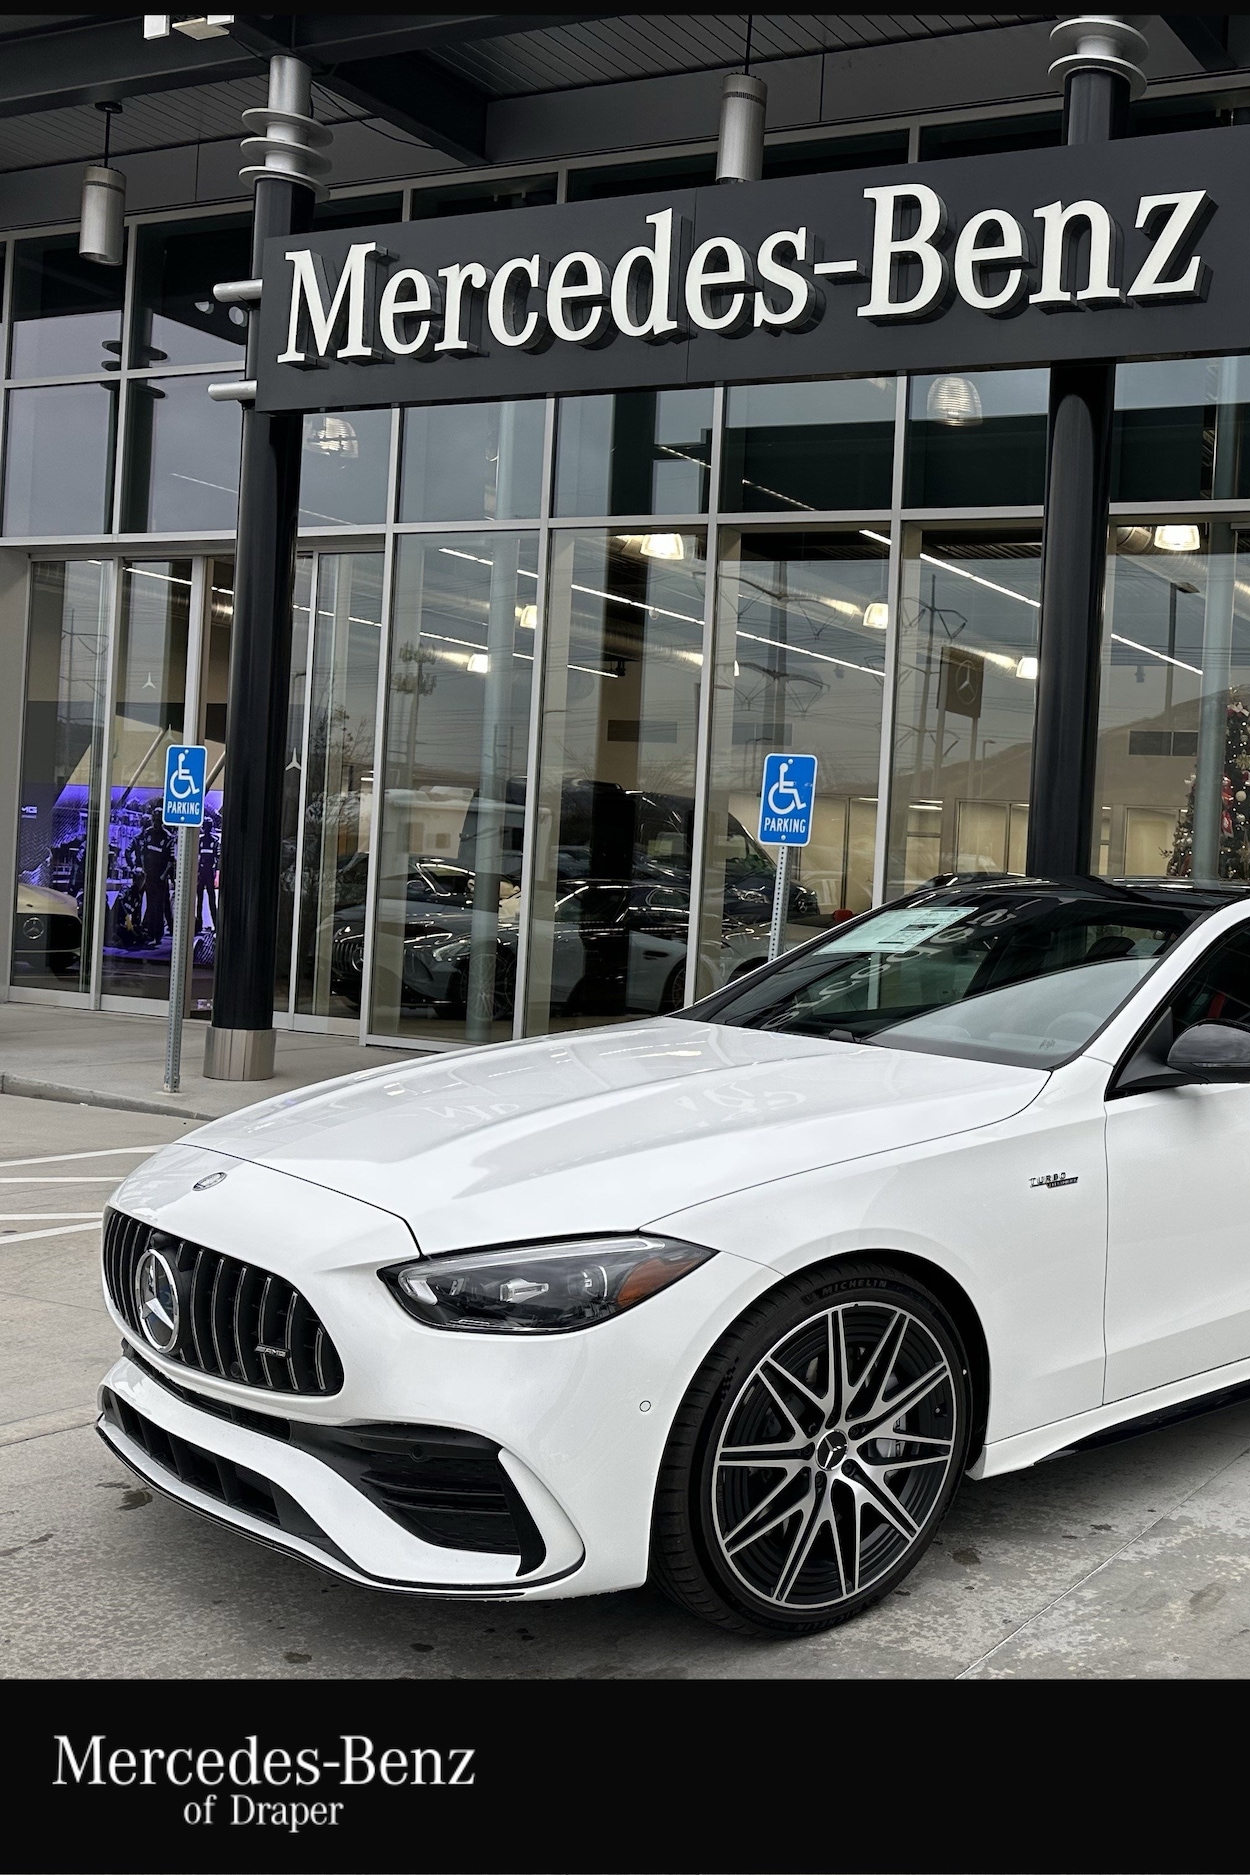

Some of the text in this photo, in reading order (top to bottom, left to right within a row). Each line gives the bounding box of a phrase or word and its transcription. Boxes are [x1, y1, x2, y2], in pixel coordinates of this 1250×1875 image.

[278, 183, 1207, 363] Mercedes-Benz
[167, 801, 200, 816] PARKING
[764, 817, 807, 833] PARKING
[822, 1278, 888, 1297] MICHELIN
